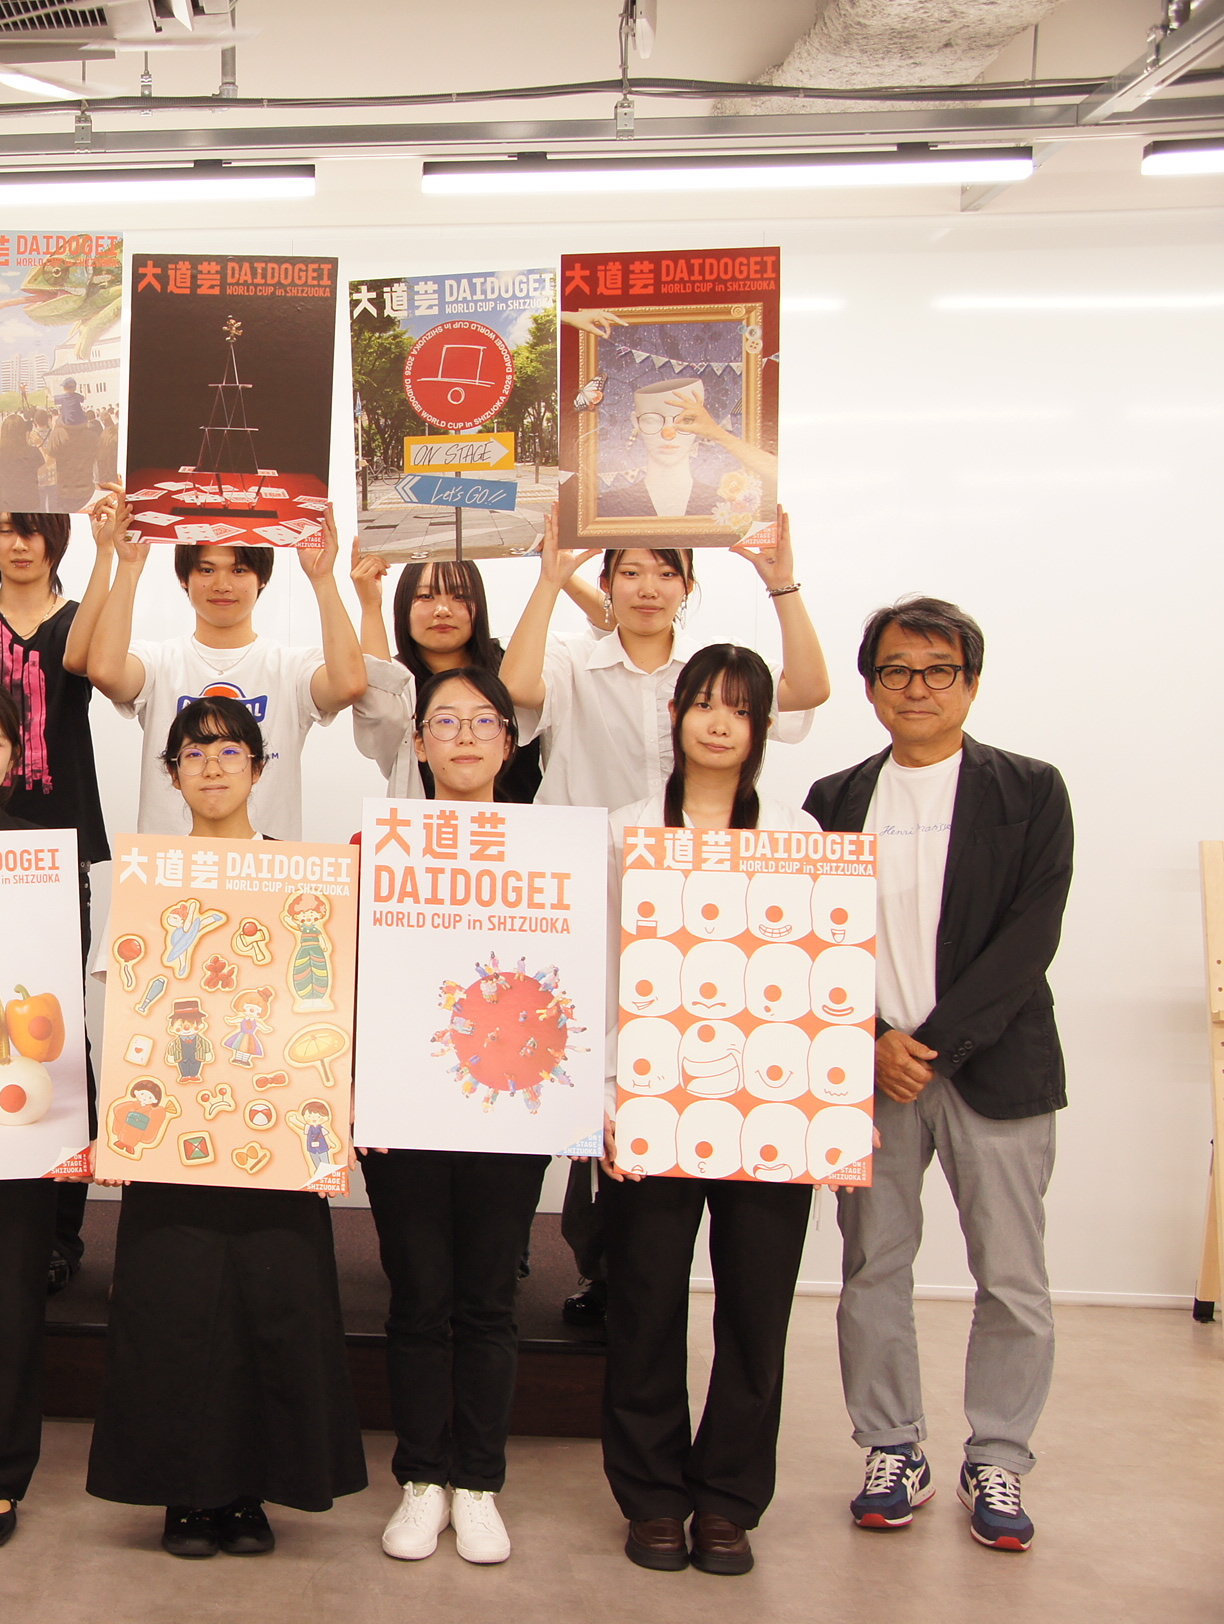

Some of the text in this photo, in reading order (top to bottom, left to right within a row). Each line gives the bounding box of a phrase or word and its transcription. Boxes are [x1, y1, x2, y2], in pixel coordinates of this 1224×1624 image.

[16, 235, 118, 256] DAIDOGEI
[138, 261, 221, 294] 大道芸
[226, 262, 332, 285] DAIDOGEI
[565, 261, 654, 296] 大道芸
[662, 256, 776, 281] DAIDOGEI
[226, 286, 330, 297] WORLD CUP in SHIZUOKA
[445, 273, 554, 301] DAIDOGEI
[662, 280, 775, 293] WORLD CUP in SHIZUOKA
[352, 281, 438, 319] 大道芸
[446, 298, 553, 313] WORLD CUP in SHIZUOKA
[411, 326, 443, 354] SHIZUOKA
[471, 324, 496, 340] WORLD
[405, 356, 414, 376] 2026
[494, 339, 512, 372] DAIDOGEI
[405, 379, 422, 412] DAIDOGEI
[421, 410, 446, 427] WORLD
[474, 396, 506, 425] SHIZUOKA
[502, 375, 512, 394] 2026
[414, 441, 494, 466] ON STAGE
[431, 478, 464, 503] Let's
[375, 808, 505, 862] 大道芸
[740, 831, 874, 861] DAIDOGEI
[626, 829, 731, 871] 大道芸
[2, 875, 11, 884] in
[13, 873, 60, 884] SHIZUOKA
[120, 847, 219, 890] 大道芸
[226, 852, 352, 883] DAIDOGEI
[740, 860, 873, 875] WORLD CUP in SHIZUOKA
[226, 879, 350, 896] WORLD CUP in SHIZUOKA
[374, 864, 571, 910] DAIDOGEI
[373, 910, 570, 934] WORLD CUP in SHIZUOKA
